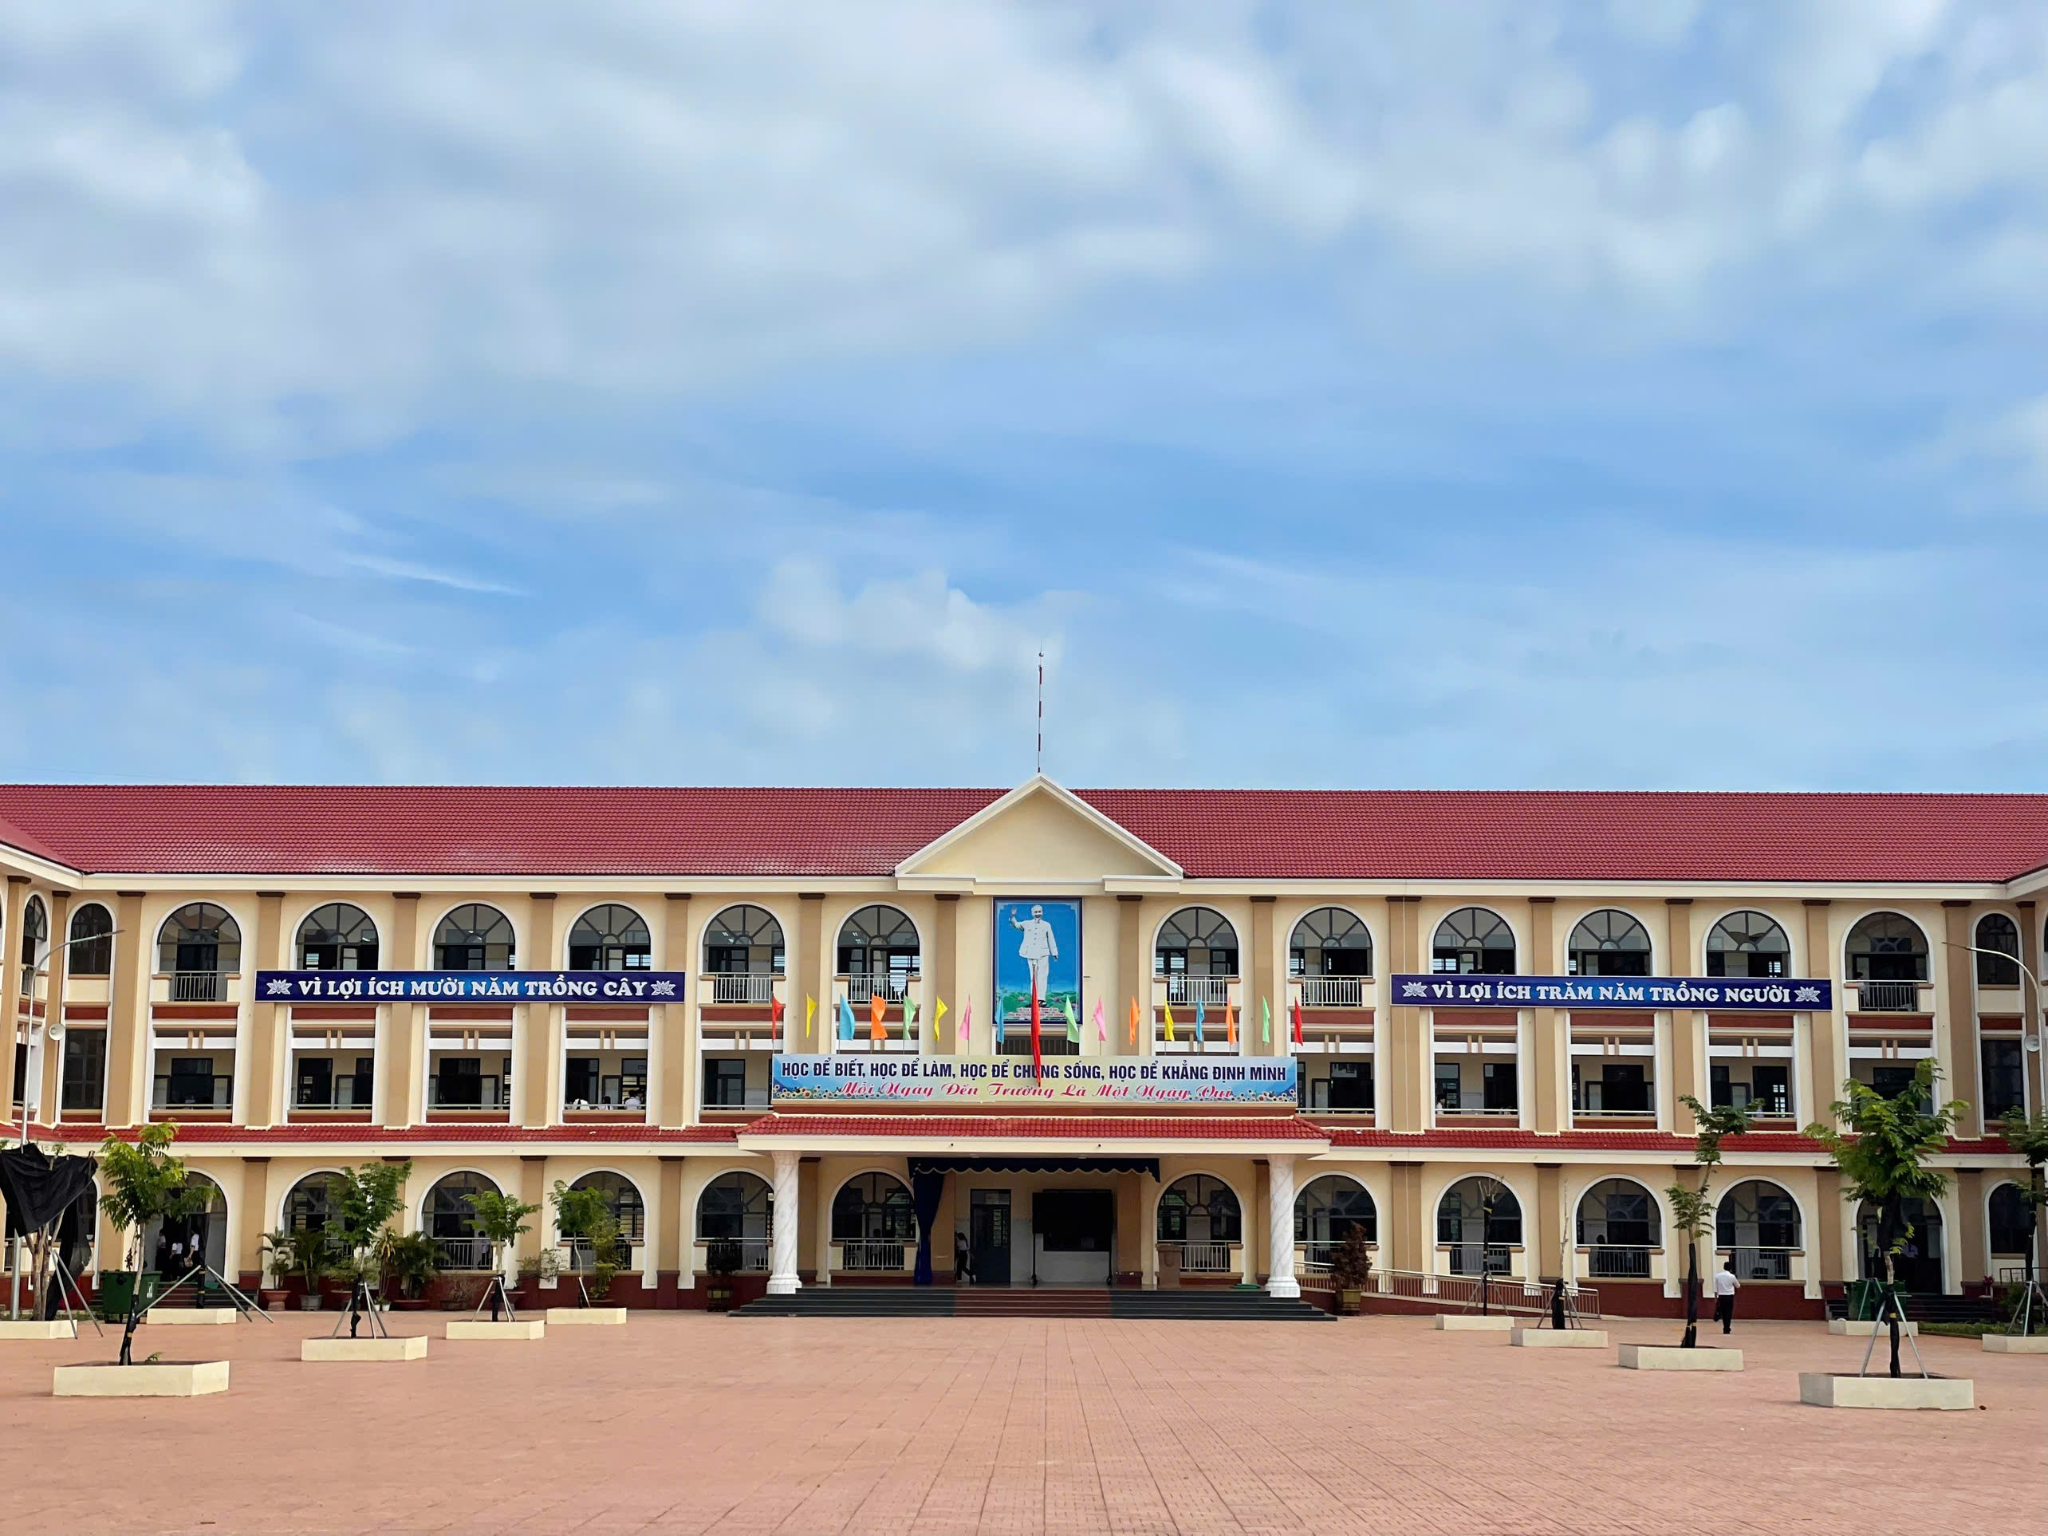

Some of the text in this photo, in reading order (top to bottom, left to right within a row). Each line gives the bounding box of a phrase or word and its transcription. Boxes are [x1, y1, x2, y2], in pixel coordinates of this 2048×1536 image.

[299, 974, 647, 999] VÌ LỢI ÍCH MƯỜI NĂM TRỒNG CÂY
[1432, 981, 1790, 1002] VÌ LỢI ÍCH TRĂM NĂM TRỒNG NGƯỜI
[782, 1062, 809, 1079] HỌC
[813, 1057, 831, 1076] ĐỂ
[835, 1058, 866, 1078] BIẾT,
[870, 1063, 897, 1080] HỌC
[901, 1058, 920, 1077] ĐỂ
[923, 1061, 956, 1079] LÀM,
[960, 1064, 987, 1081] HỌC
[991, 1059, 1010, 1078] ĐỂ
[1064, 1060, 1105, 1081] SỐNG,
[1109, 1065, 1136, 1082] HỌC
[1140, 1060, 1158, 1080] ĐỂ
[1162, 1059, 1208, 1080] KHẲNG
[1212, 1066, 1245, 1083] ĐỊNH
[1250, 1064, 1286, 1081] MÌNH
[840, 1081, 874, 1094] Mỗi
[881, 1082, 933, 1097] Ngày
[941, 1083, 979, 1095] Đến
[987, 1083, 1054, 1099] Trường
[1060, 1084, 1086, 1096] Là
[1092, 1084, 1129, 1099] Một
[1136, 1085, 1189, 1100] Ngày
